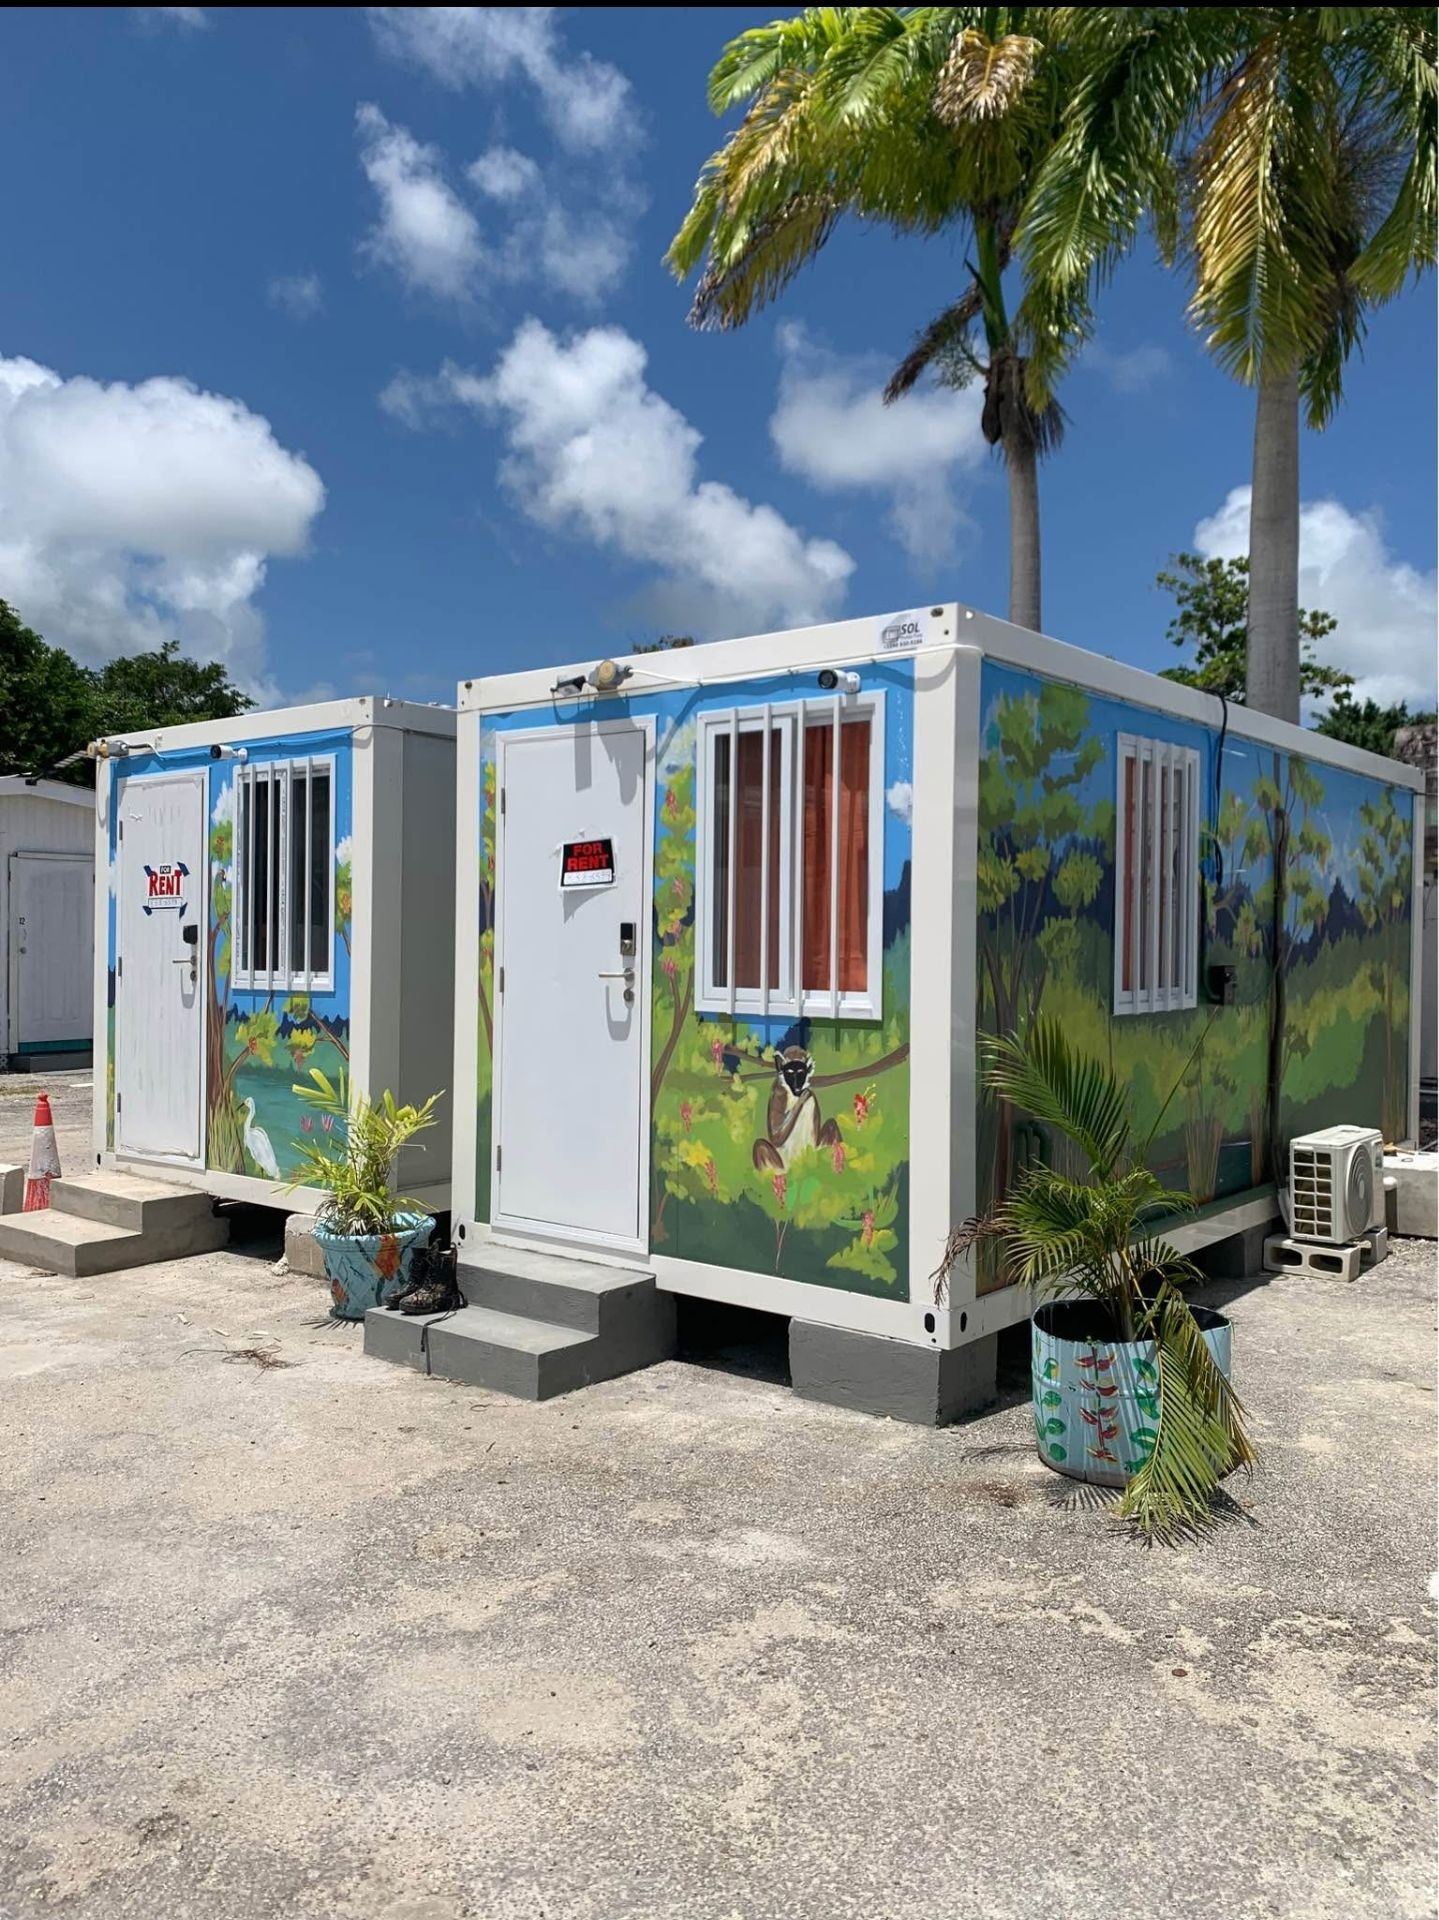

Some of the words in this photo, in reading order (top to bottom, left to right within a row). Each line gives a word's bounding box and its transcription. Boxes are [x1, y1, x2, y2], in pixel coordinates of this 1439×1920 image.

[901, 622, 920, 634] SOL
[573, 842, 603, 856] FOR
[567, 853, 609, 870] RENT
[149, 869, 181, 896] RENT
